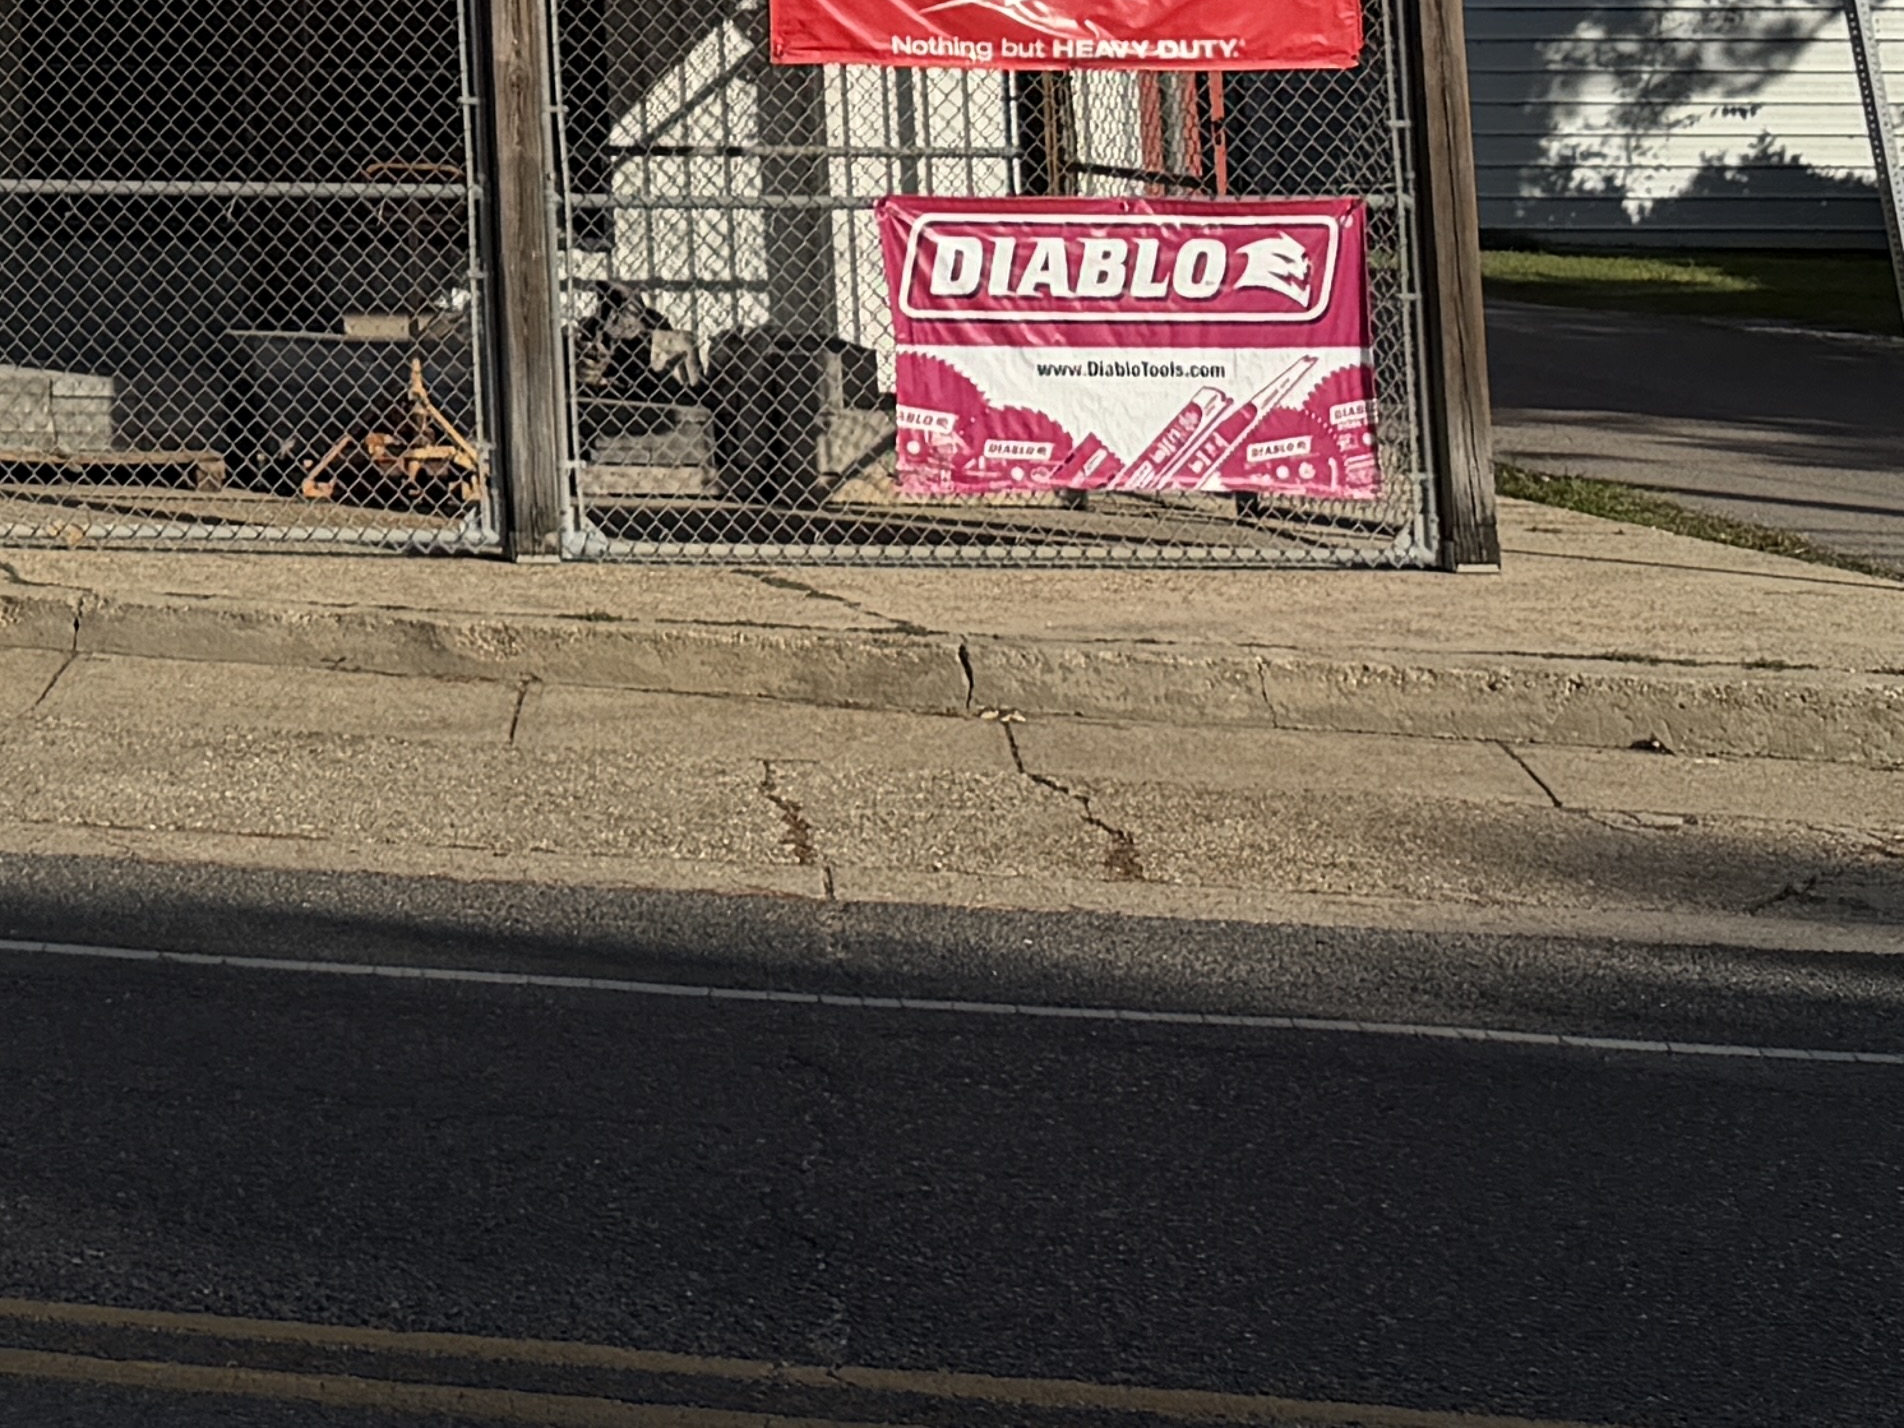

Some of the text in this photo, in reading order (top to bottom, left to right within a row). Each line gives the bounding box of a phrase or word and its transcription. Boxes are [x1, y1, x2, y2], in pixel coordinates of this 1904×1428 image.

[892, 35, 992, 61] Nothing
[1001, 37, 1044, 58] but
[929, 234, 1228, 299] DIABLO
[1036, 360, 1226, 378] www.DiabloTools.com
[988, 443, 1034, 457] DIABLO
[1250, 442, 1295, 459] DIABLO
